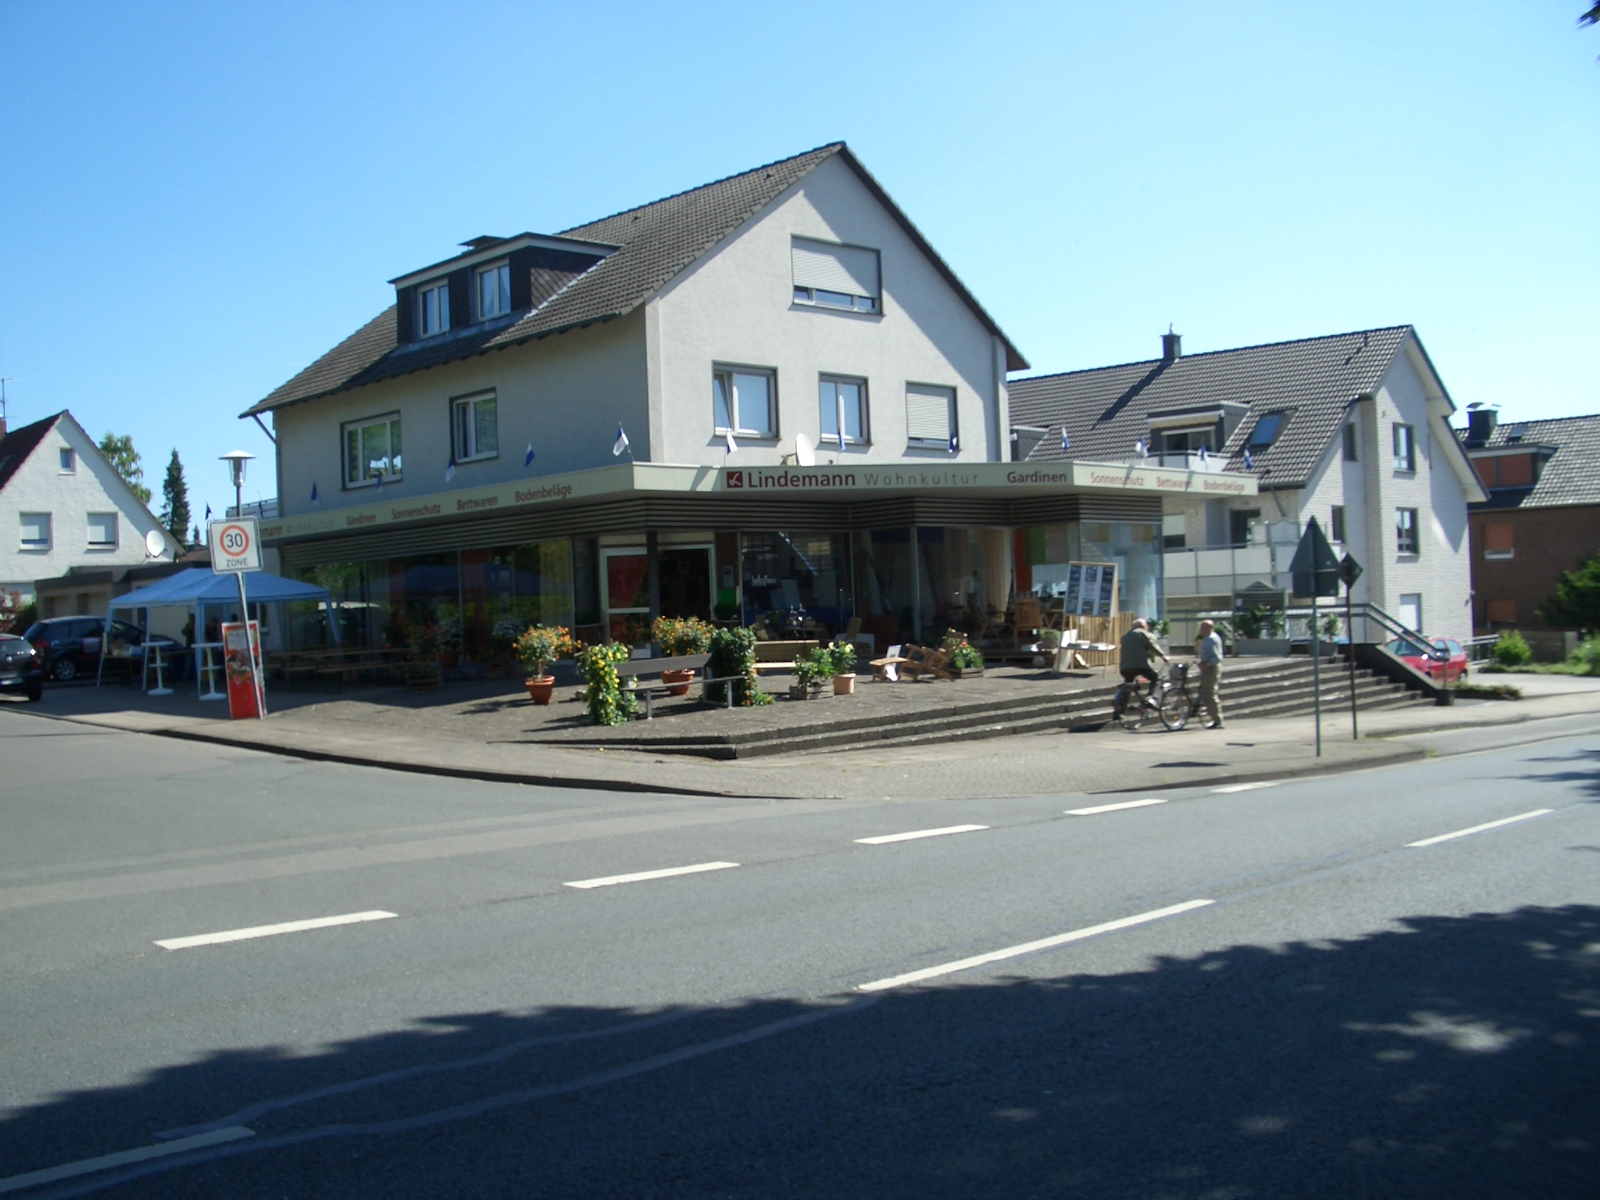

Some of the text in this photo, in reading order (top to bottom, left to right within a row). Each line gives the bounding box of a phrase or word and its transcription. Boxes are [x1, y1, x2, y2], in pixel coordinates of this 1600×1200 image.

[748, 470, 1068, 488] Lindemann Wohnkultur Gardinen
[391, 502, 441, 519] Sonnenschutz
[457, 496, 498, 510] Bettwaren
[515, 484, 572, 502] Bodenbeläge
[225, 533, 243, 548] 30
[226, 558, 249, 568] ZONE
